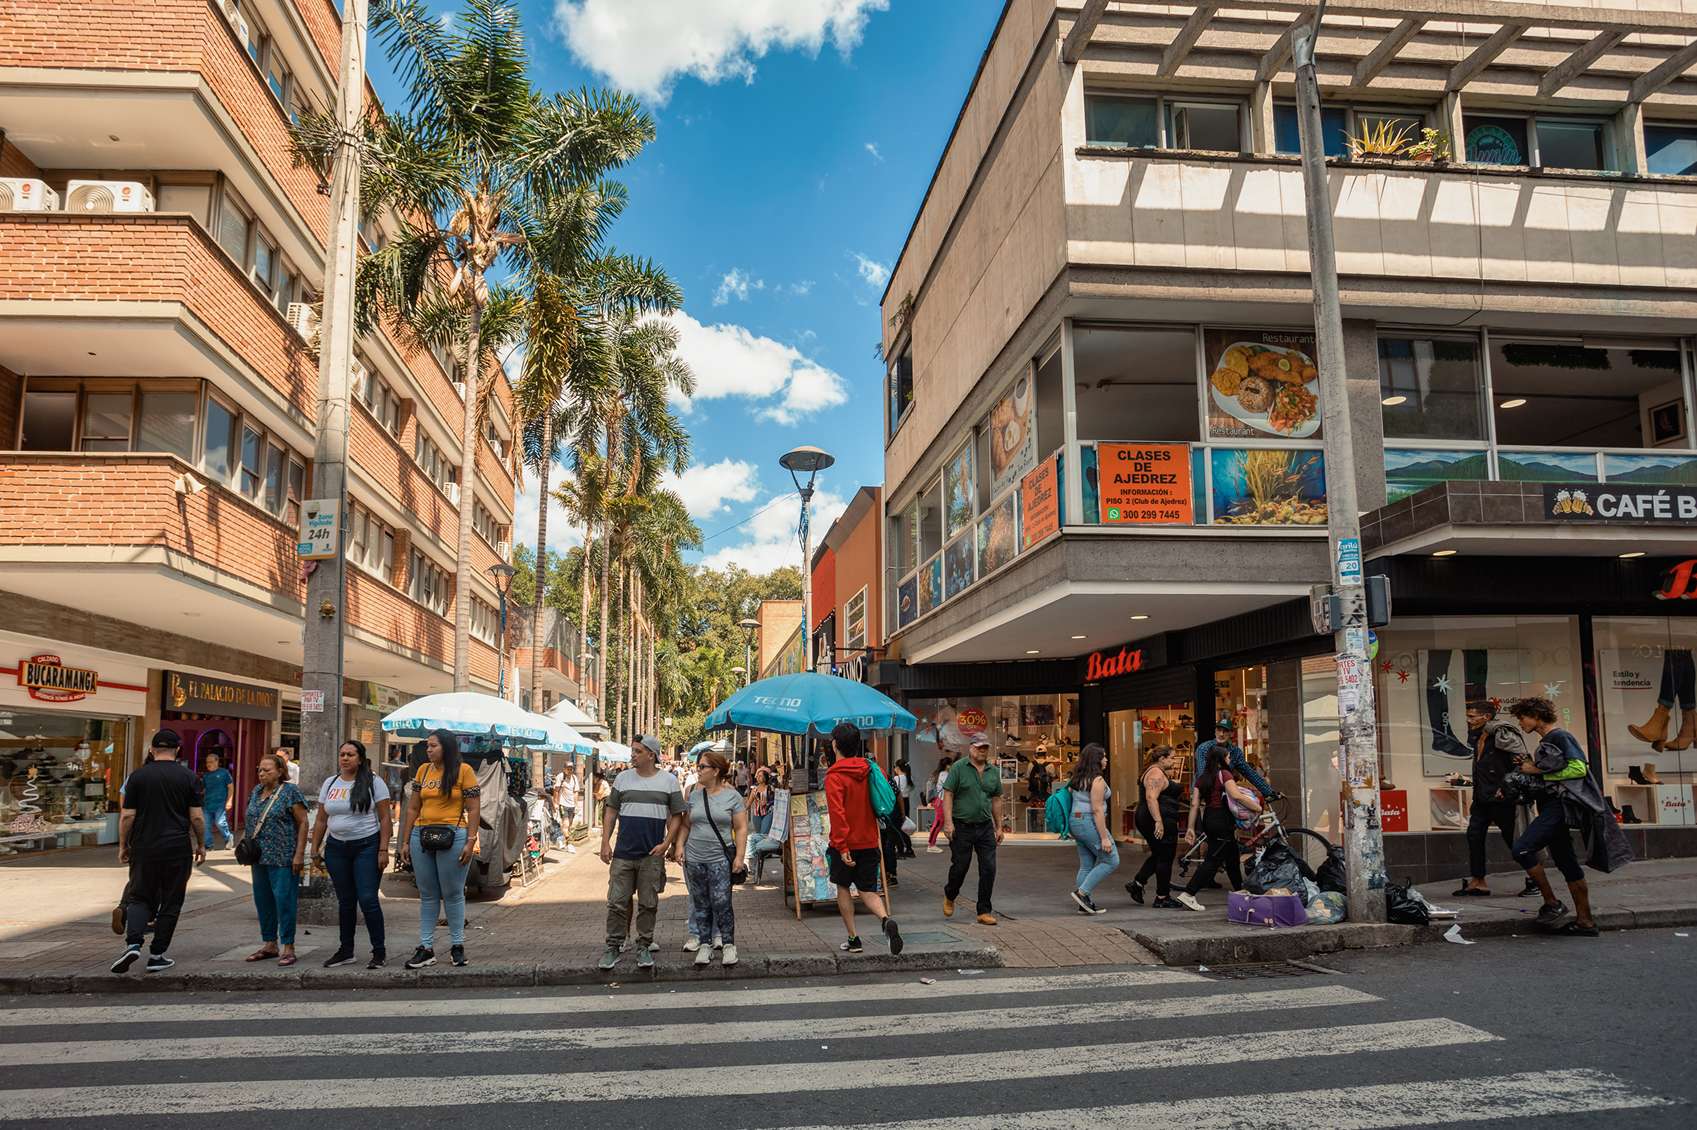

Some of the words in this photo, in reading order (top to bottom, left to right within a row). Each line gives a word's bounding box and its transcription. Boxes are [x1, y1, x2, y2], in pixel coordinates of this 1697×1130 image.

[1212, 427, 1255, 436] Restaurant
[1117, 450, 1171, 461] CLASES
[1134, 462, 1152, 472] DE
[1114, 474, 1177, 484] AJEDREZ
[1132, 498, 1149, 506] (Club
[1597, 489, 1673, 518] CAFÉ
[1123, 510, 1139, 519] 300
[1141, 510, 1157, 519] 299
[1160, 510, 1180, 519] 7445
[308, 528, 330, 540] 24h
[1087, 648, 1143, 681] Bata
[27, 663, 97, 692] BUCARAMANGA
[1613, 670, 1634, 678] Estilo
[833, 716, 873, 726] TENO
[960, 715, 986, 725] 30%
